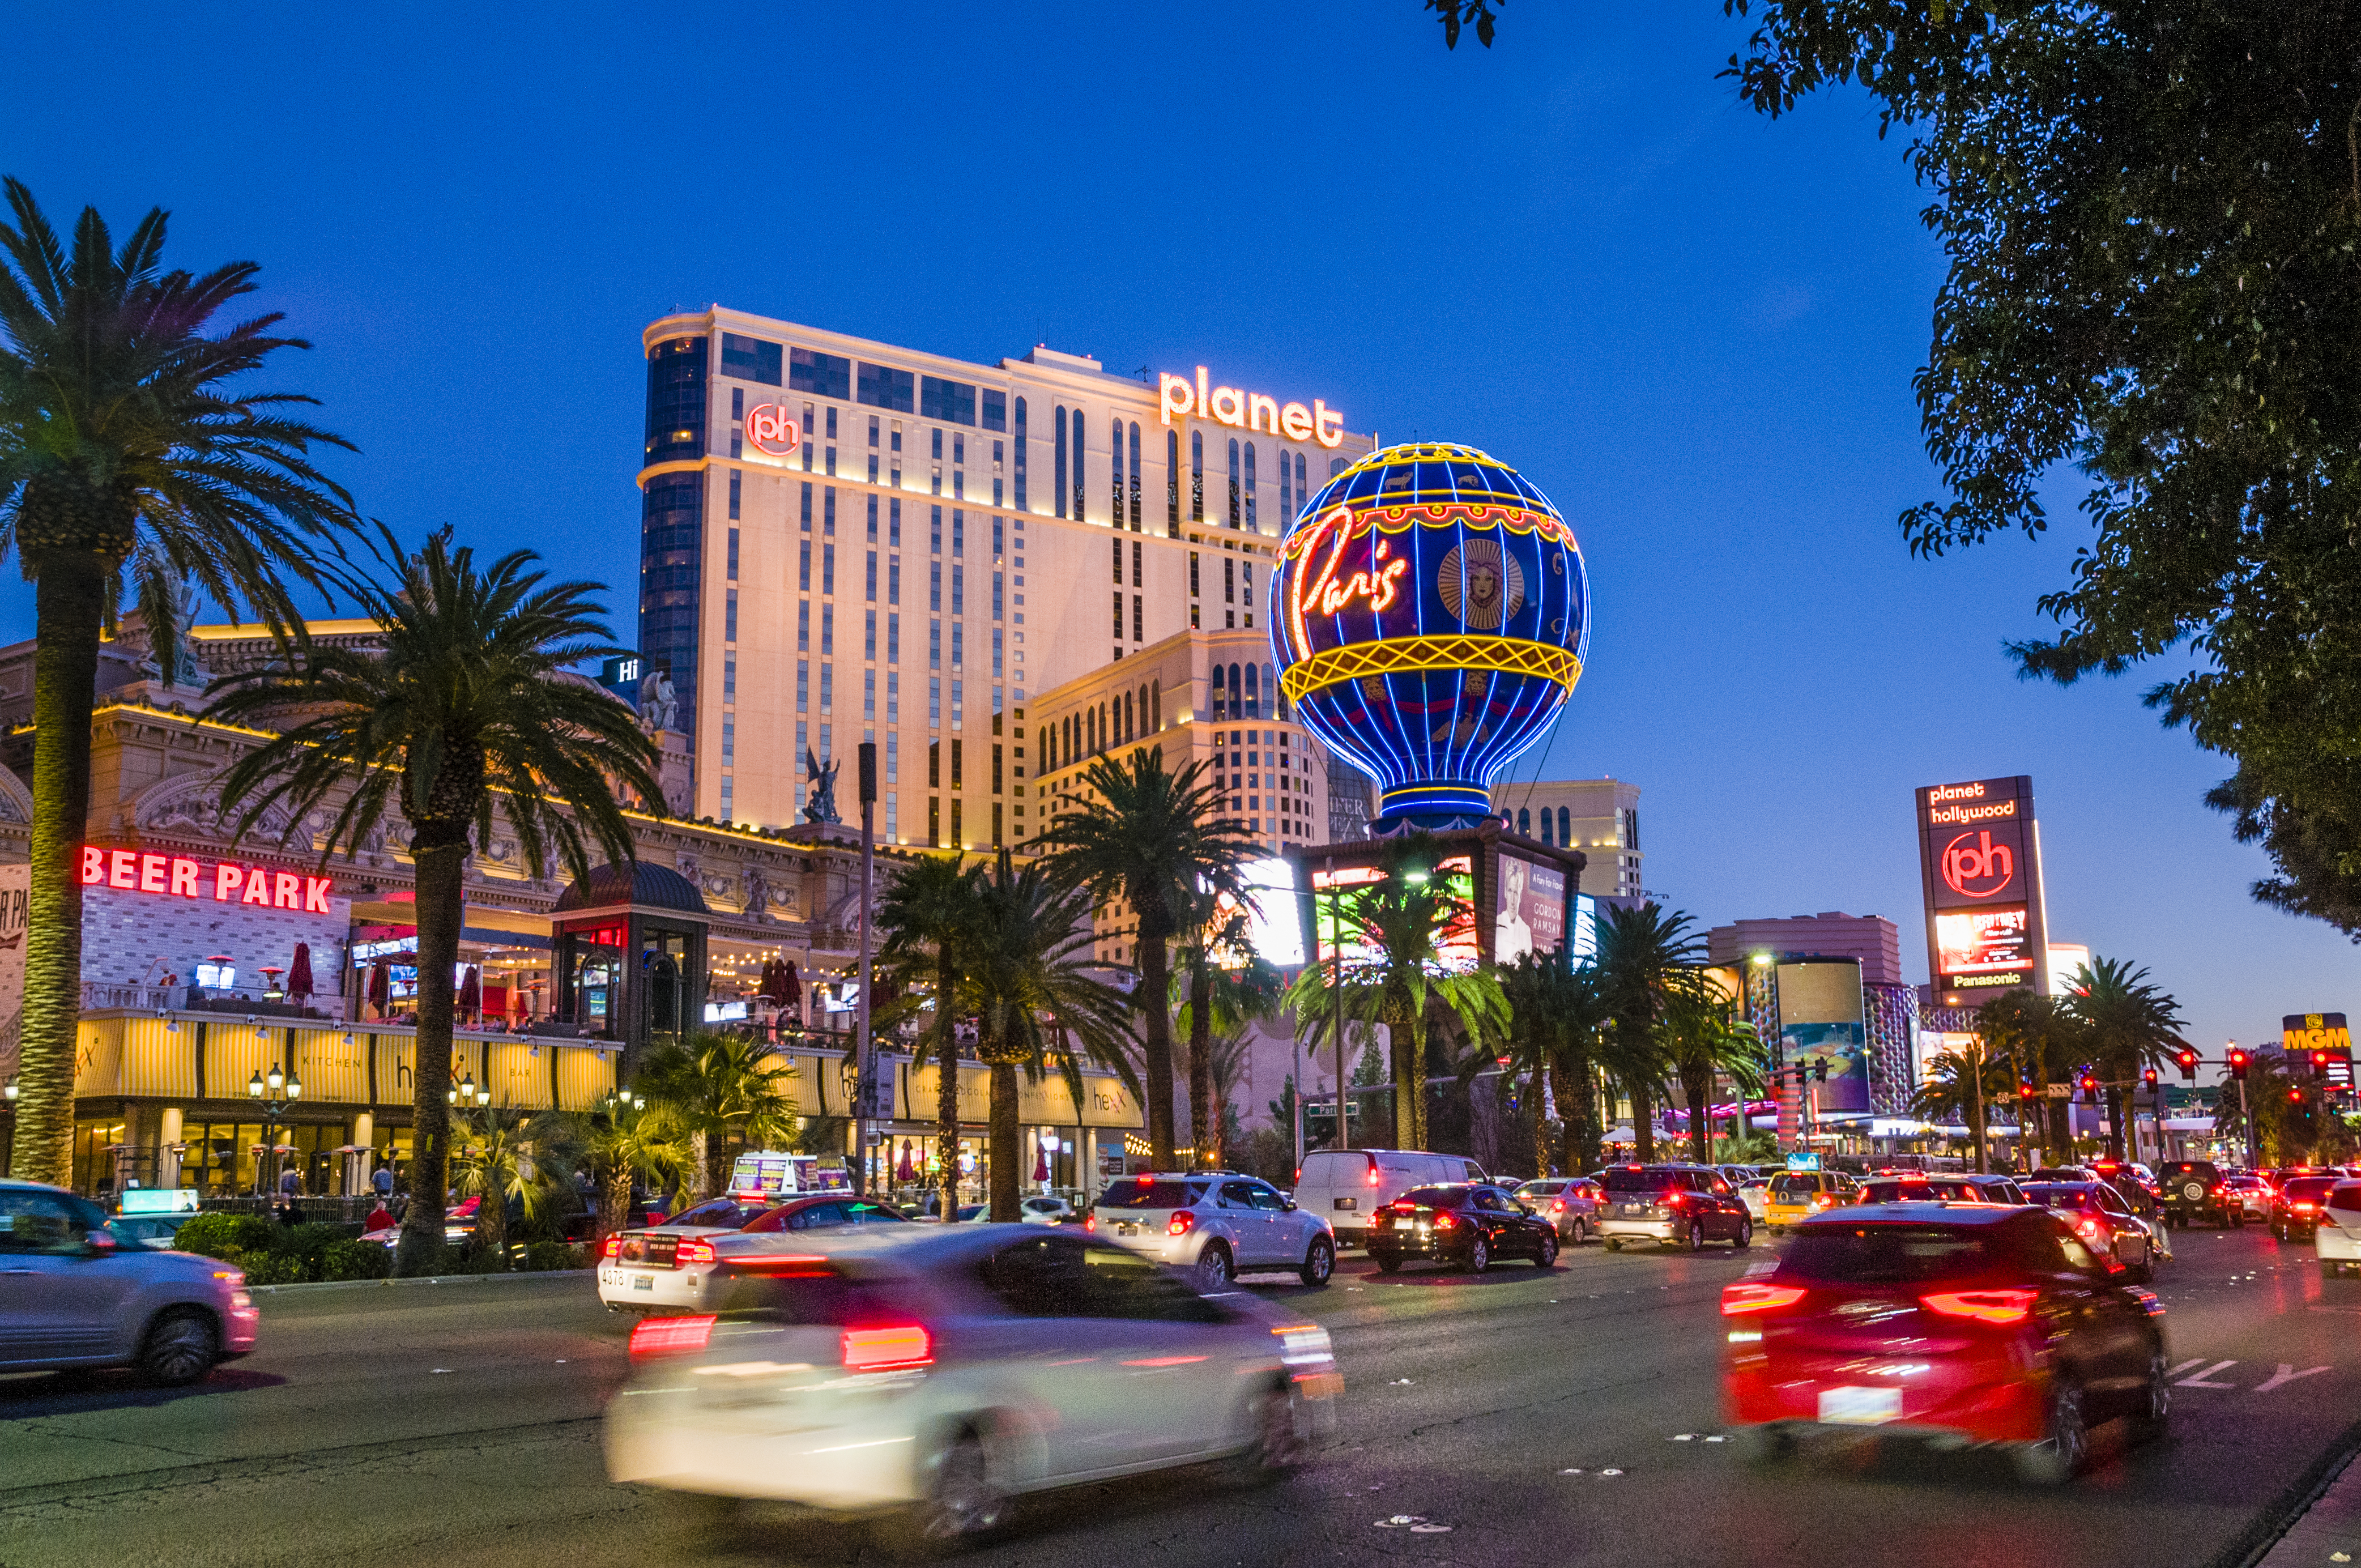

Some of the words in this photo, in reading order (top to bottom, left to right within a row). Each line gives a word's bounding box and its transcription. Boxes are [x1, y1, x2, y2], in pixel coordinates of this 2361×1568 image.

[1160, 365, 1344, 448] planet
[754, 405, 800, 446] ph
[1293, 506, 1407, 662] Paris
[1930, 783, 1984, 806] planet
[1932, 800, 2014, 824] hollywood
[1949, 830, 2013, 889] ph
[83, 846, 199, 897] BEER
[216, 863, 331, 913] PARK
[1534, 903, 1561, 921] GORDON
[1533, 918, 1561, 935] RAMSAY
[1954, 972, 2021, 987] Panasonic
[2283, 1028, 2351, 1050] MGM
[303, 1056, 360, 1068] KITCHEN
[510, 1068, 530, 1077] BAR
[603, 1270, 623, 1285] 4378
